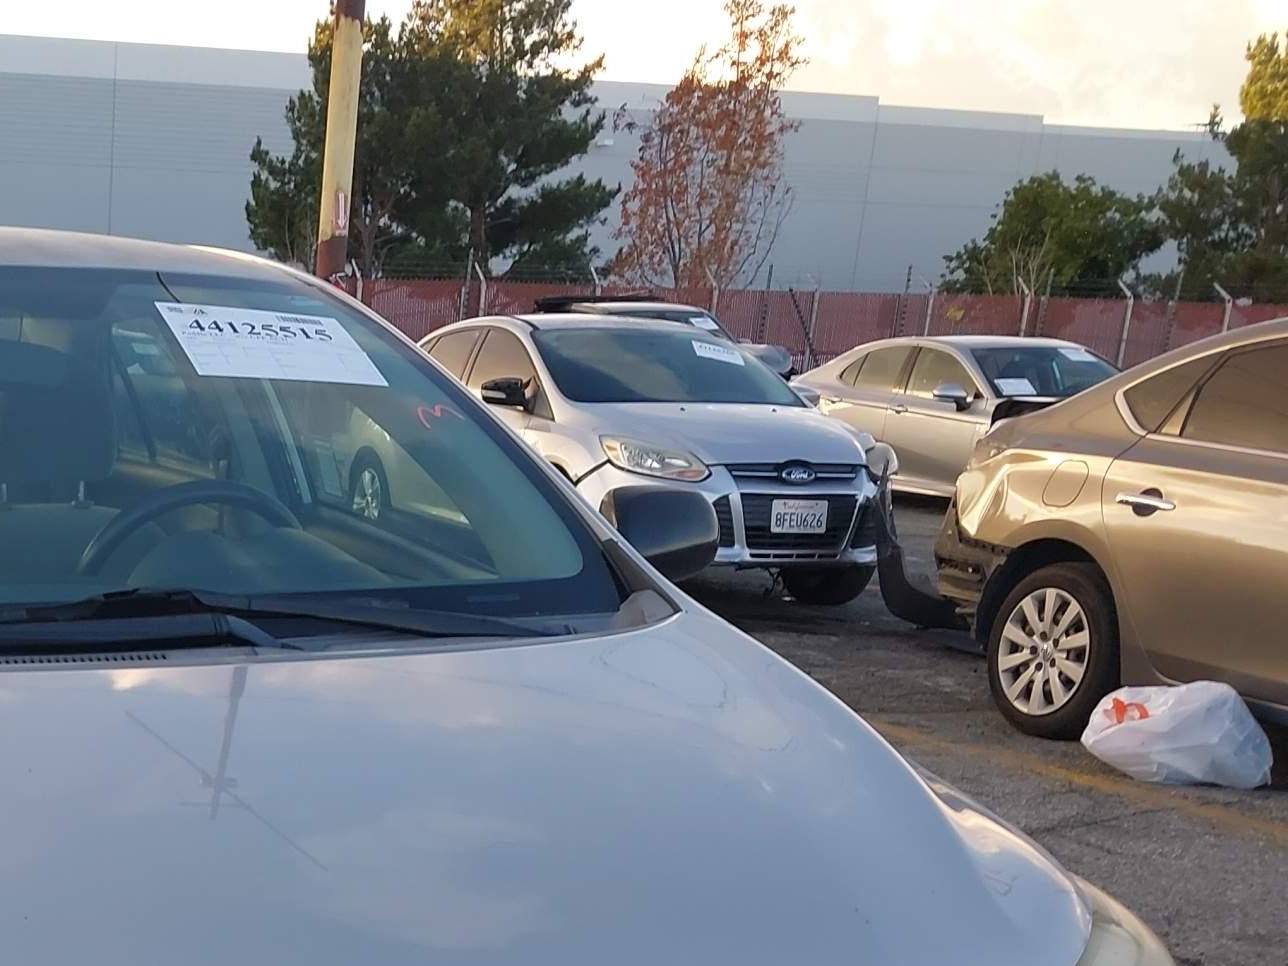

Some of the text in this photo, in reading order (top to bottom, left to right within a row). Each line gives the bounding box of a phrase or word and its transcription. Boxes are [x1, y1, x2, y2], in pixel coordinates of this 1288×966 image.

[189, 318, 333, 342] 44125515
[790, 470, 809, 480] Ford
[783, 501, 815, 512] Calif
[775, 511, 824, 529] 8FEU626
